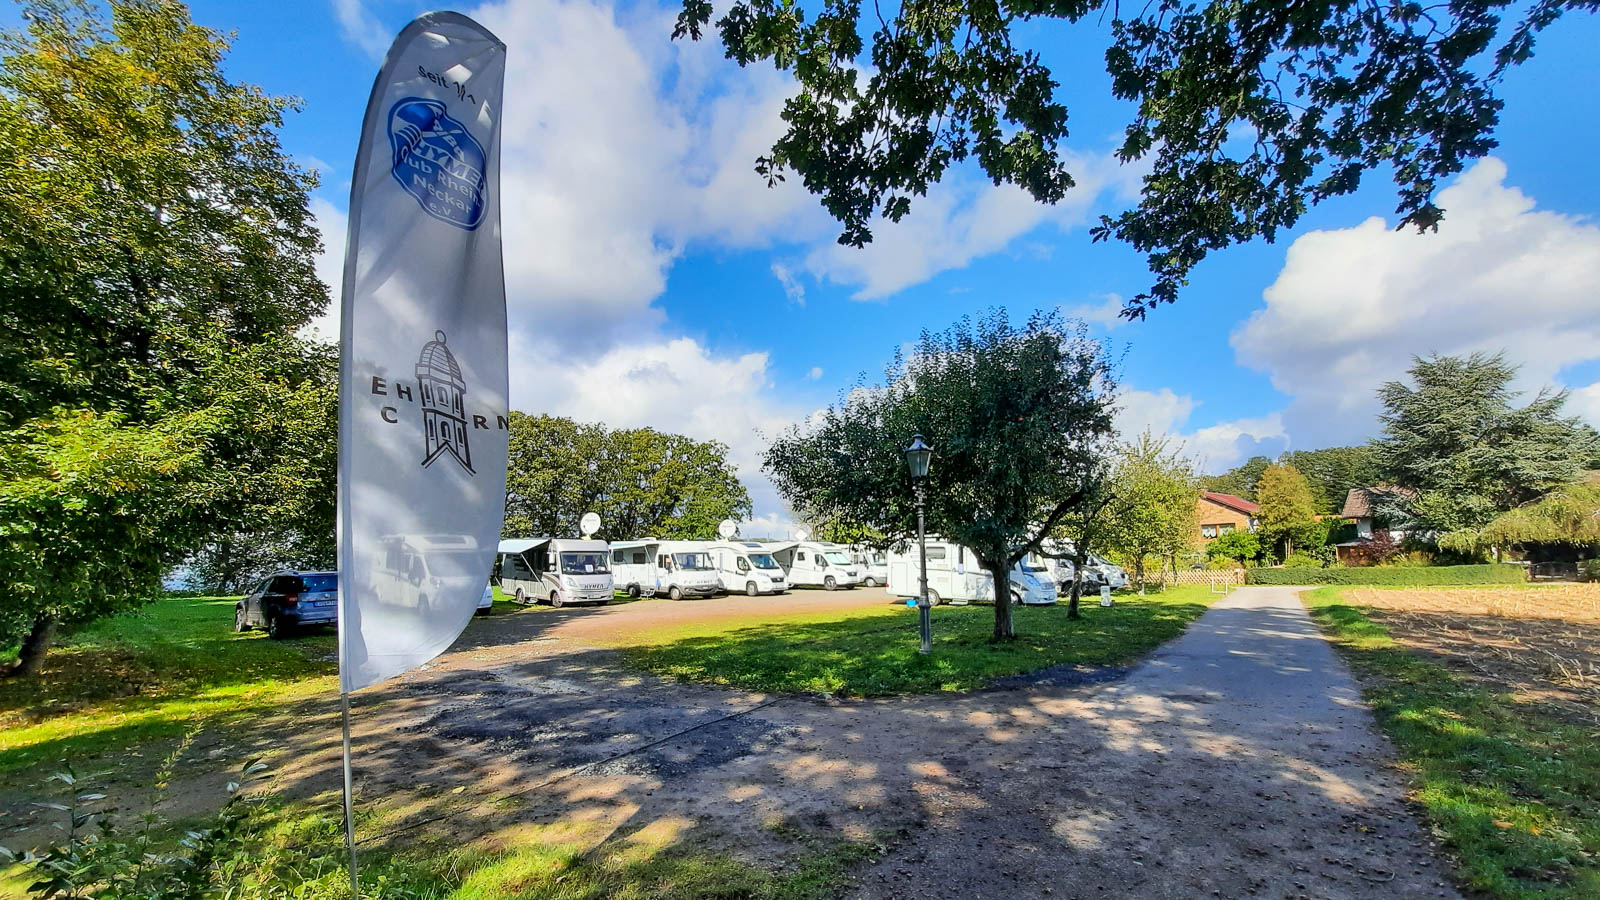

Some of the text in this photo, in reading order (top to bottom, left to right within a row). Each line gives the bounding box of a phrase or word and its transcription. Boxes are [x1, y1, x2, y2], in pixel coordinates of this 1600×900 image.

[418, 65, 449, 89] Seit
[413, 173, 472, 214] Neckar
[429, 202, 455, 218] e.V.
[380, 407, 398, 424] C
